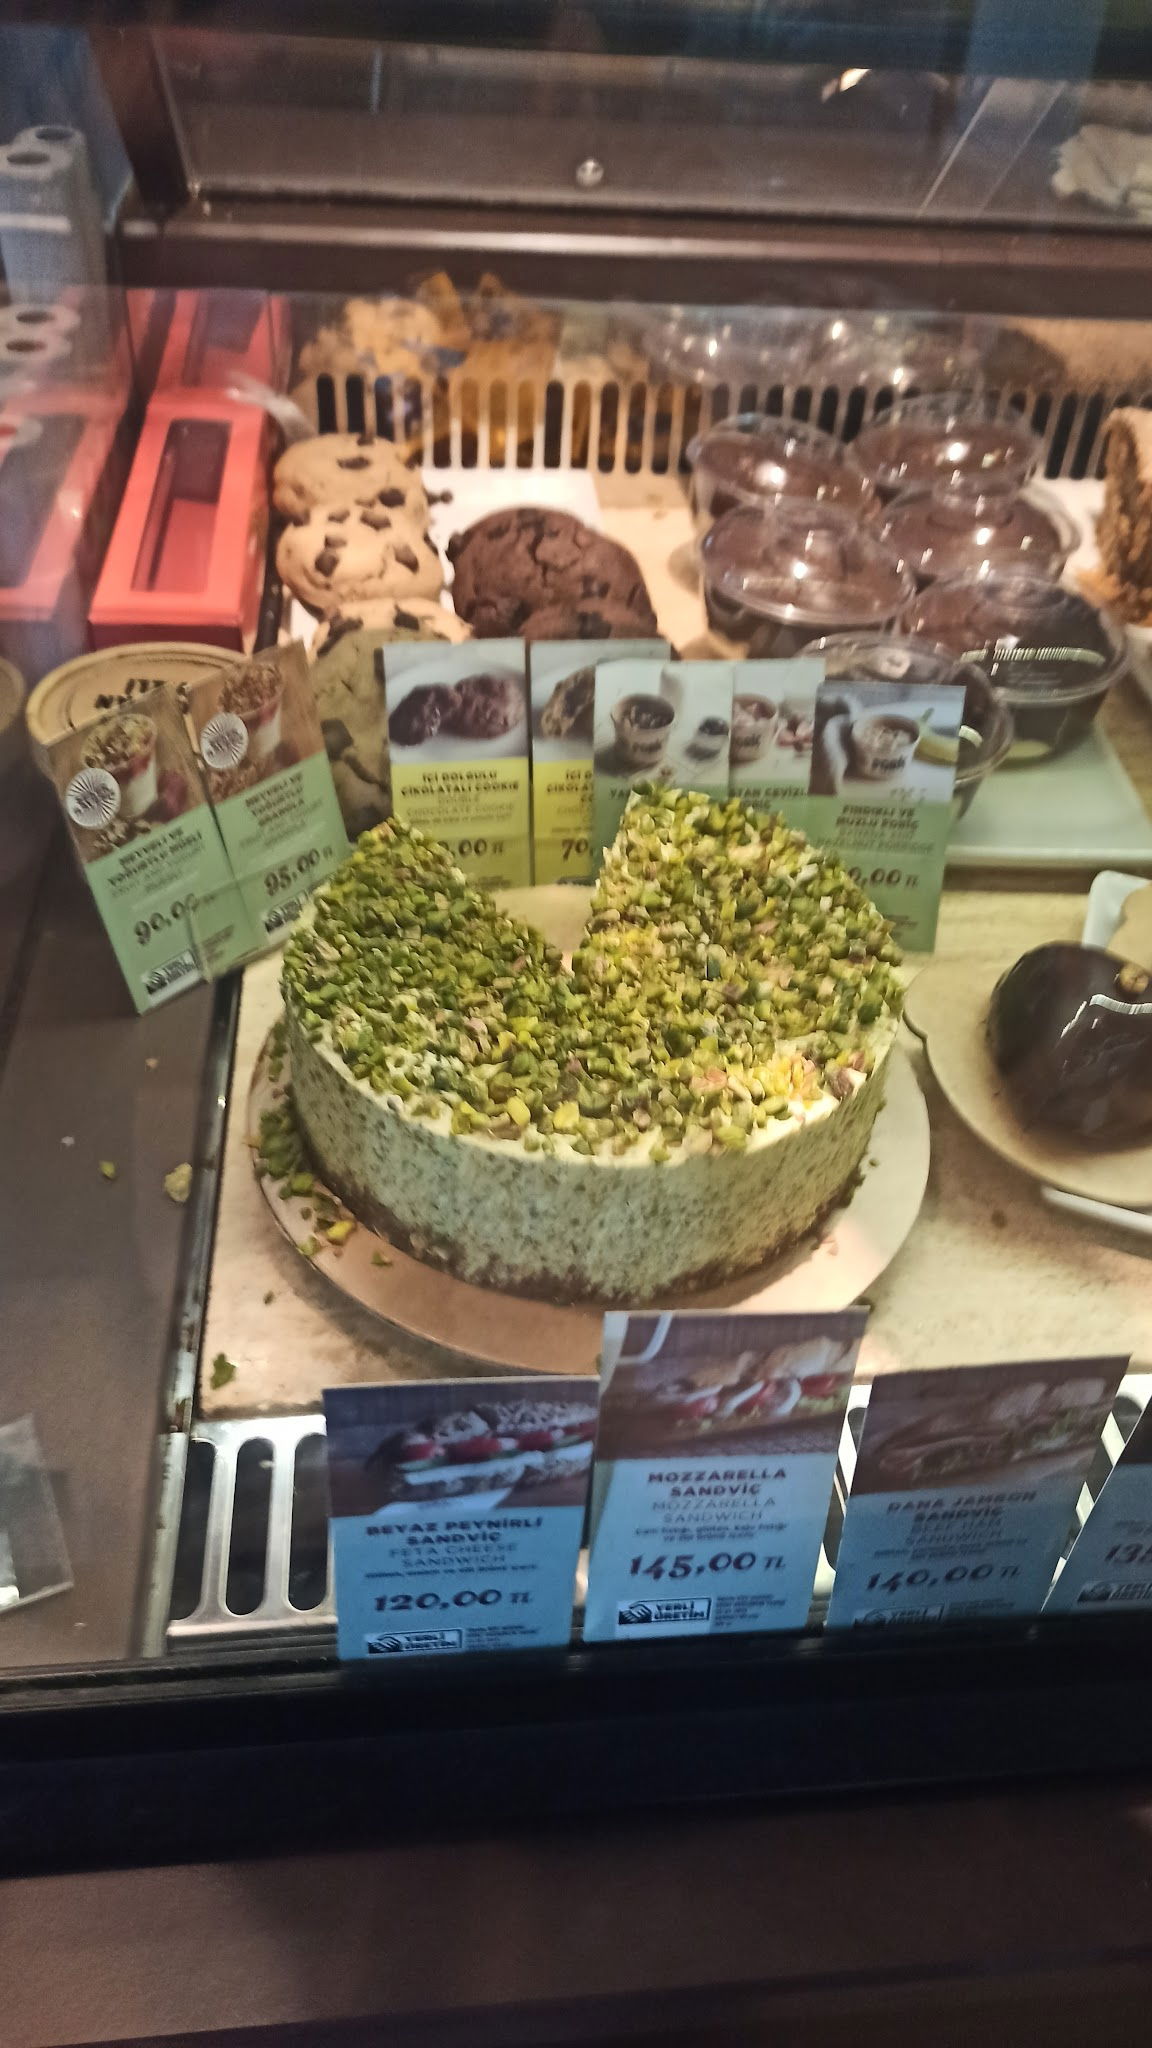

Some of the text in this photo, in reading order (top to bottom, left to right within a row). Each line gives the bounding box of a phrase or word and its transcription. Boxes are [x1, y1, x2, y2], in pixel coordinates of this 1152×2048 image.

[263, 848, 320, 897] 95,00
[648, 1468, 787, 1484] MOZZARELLA
[670, 1482, 762, 1498] SANDVİÇ
[652, 1497, 776, 1512] MOZZARELLA
[887, 1499, 945, 1514] DANA
[662, 1511, 763, 1524] SANDWICH
[366, 1516, 543, 1536] BEYAZ PEYNİRLİ
[406, 1531, 503, 1546] SANDVİÇ
[401, 1555, 506, 1568] SANDWICH
[629, 1551, 786, 1581] 145,00 TL
[866, 1563, 995, 1593] 140,00
[374, 1588, 531, 1613] 120,00 TL
[655, 1600, 696, 1612] YERLİ
